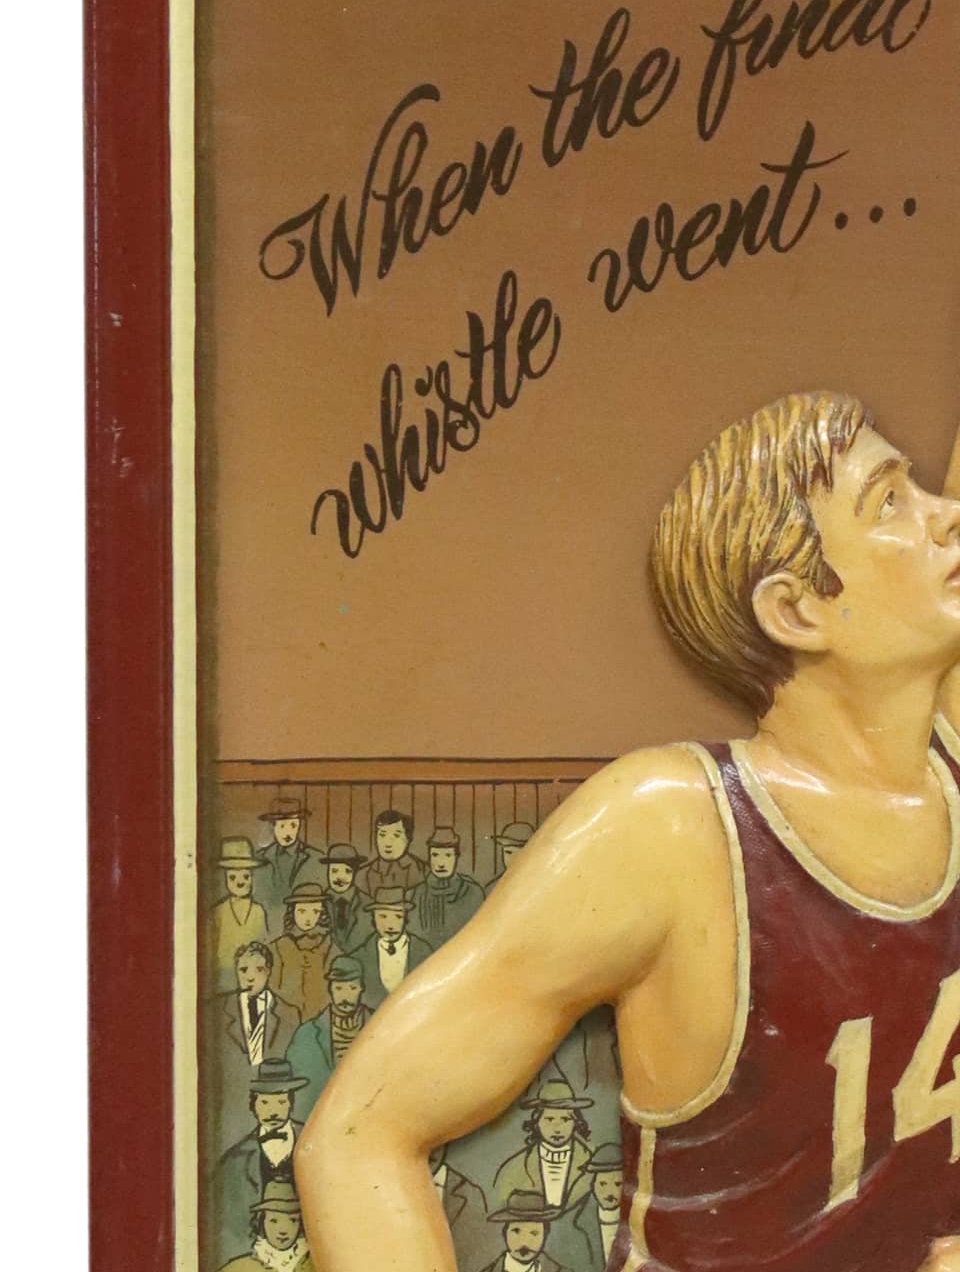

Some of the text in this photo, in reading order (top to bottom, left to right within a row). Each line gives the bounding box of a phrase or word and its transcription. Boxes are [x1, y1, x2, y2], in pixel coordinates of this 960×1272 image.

[259, 83, 523, 317] When
[529, 7, 680, 167] the
[310, 270, 561, 558] whistle
